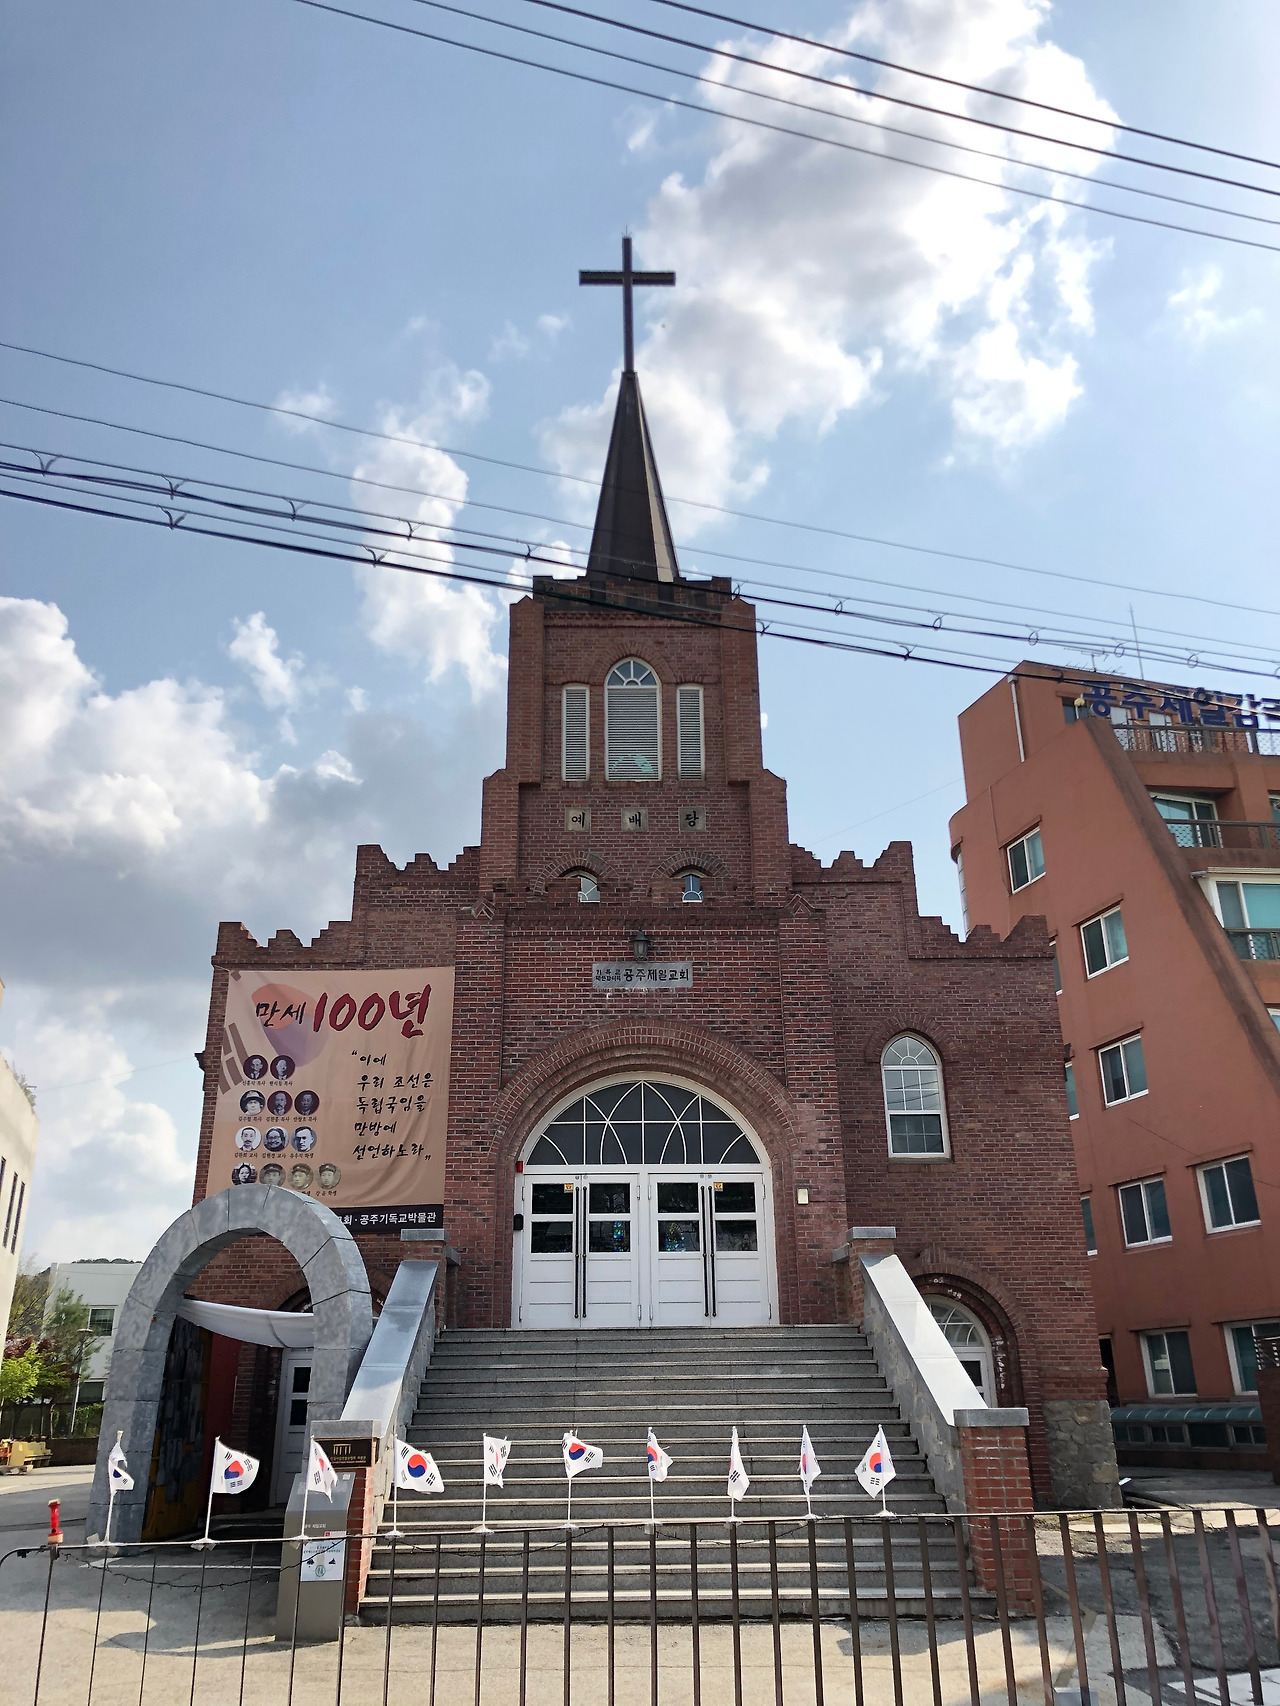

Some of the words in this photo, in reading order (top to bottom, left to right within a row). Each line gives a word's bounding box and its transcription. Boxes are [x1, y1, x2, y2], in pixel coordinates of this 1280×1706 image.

[571, 811, 586, 828] 예
[628, 811, 642, 828] 배
[685, 810, 700, 828] 당
[623, 968, 689, 982] 공주제일교회
[255, 1000, 307, 1027] 만세
[313, 983, 432, 1039] 100년
[357, 1074, 384, 1091] 우리
[393, 1072, 434, 1089] 조선은
[356, 1095, 427, 1114] 독립국임을
[354, 1120, 398, 1137] 만방에
